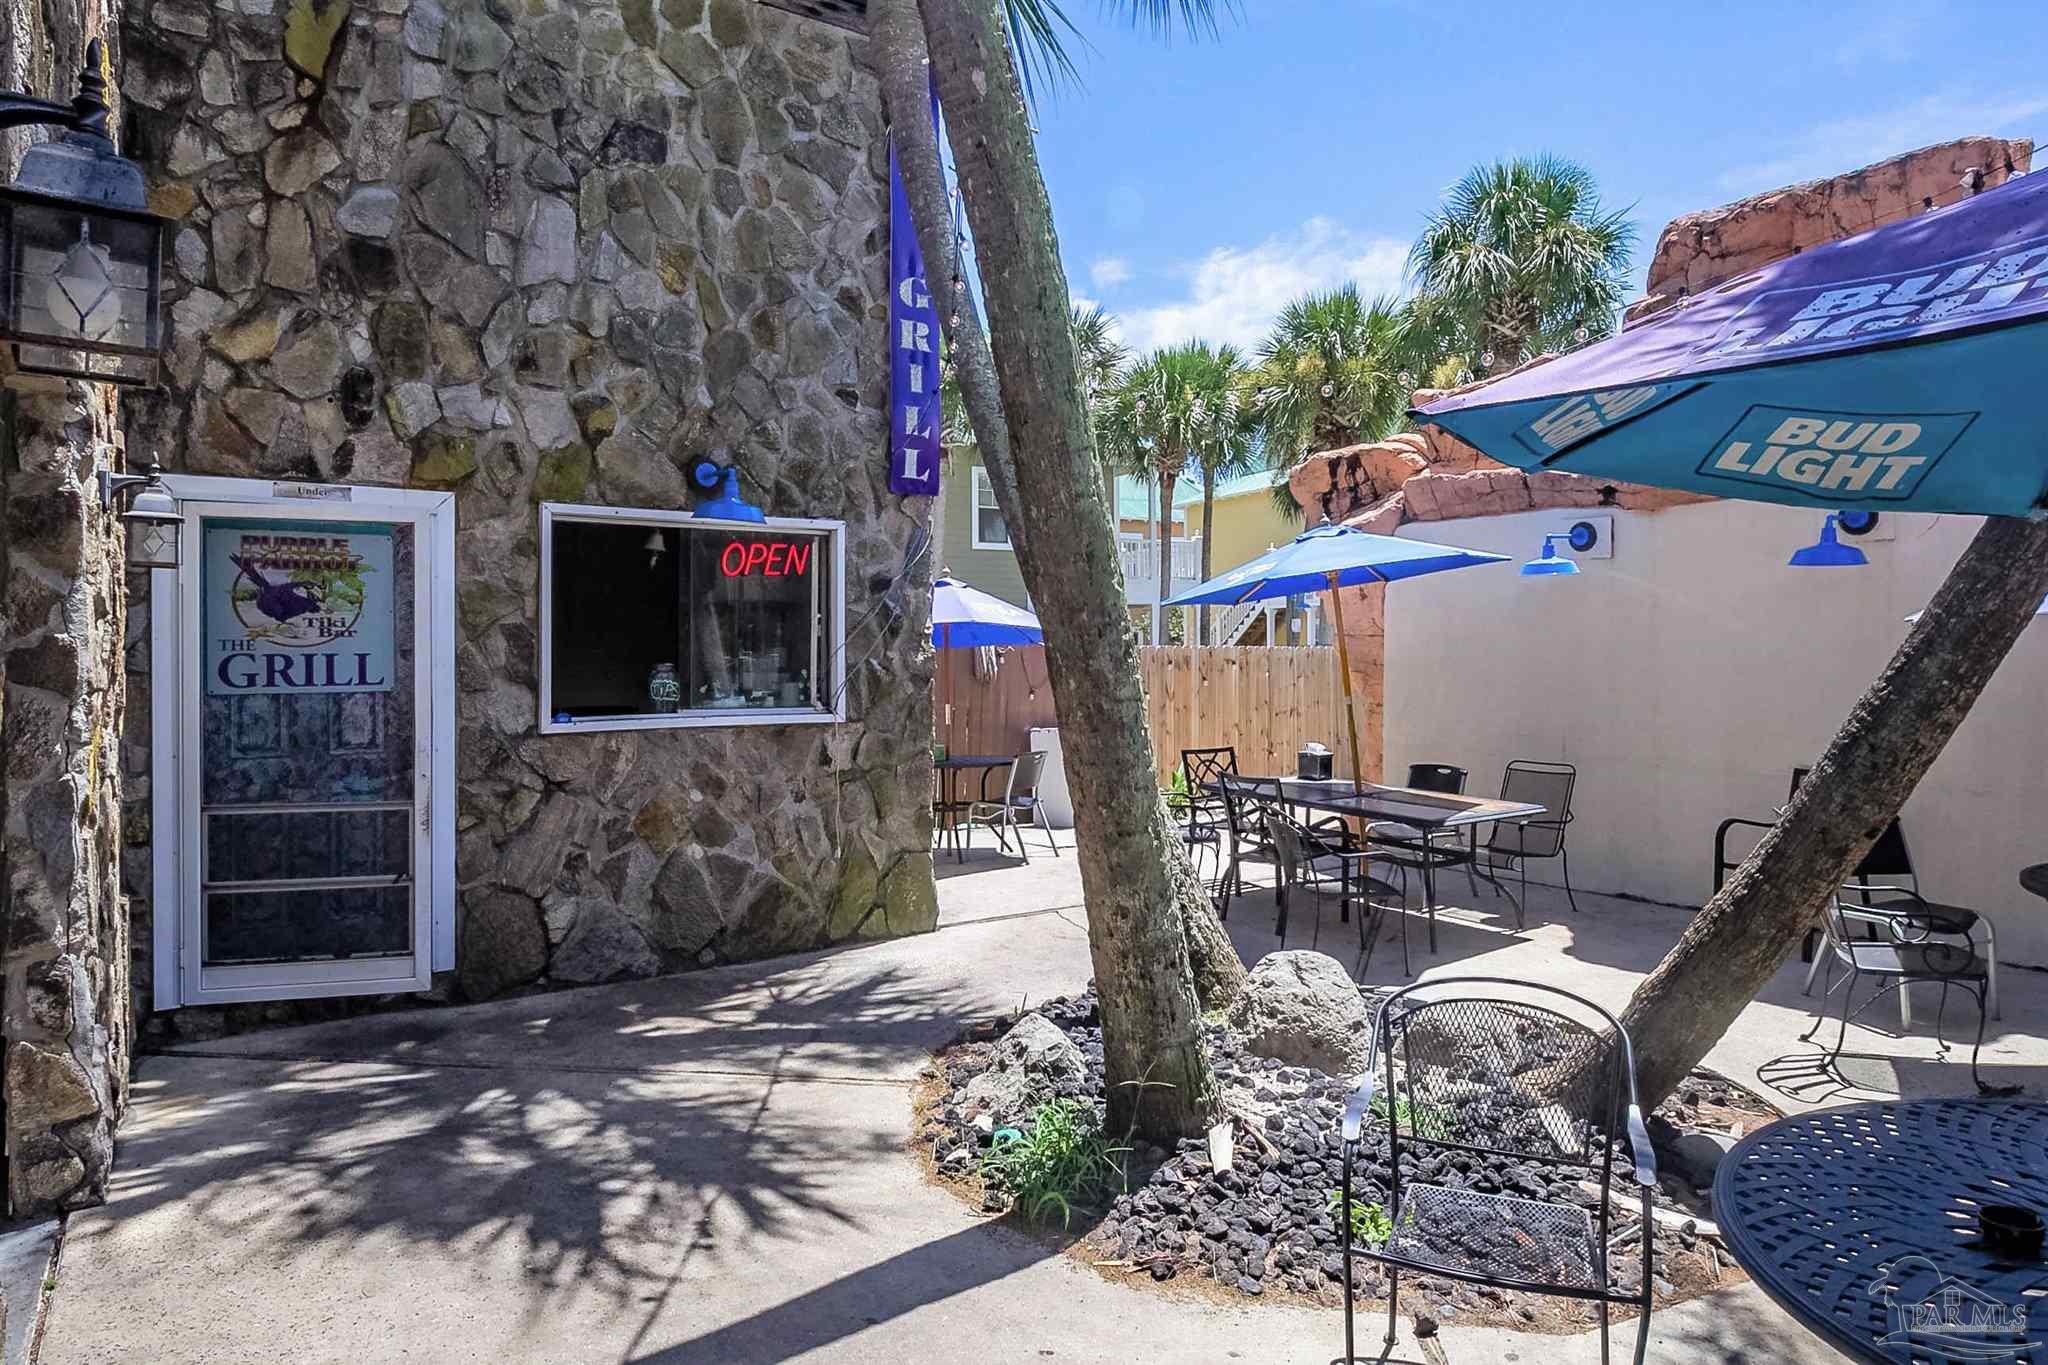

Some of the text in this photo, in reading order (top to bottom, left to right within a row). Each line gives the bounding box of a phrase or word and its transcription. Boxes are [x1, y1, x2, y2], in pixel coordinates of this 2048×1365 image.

[1789, 244, 2048, 321] BUD
[898, 276, 932, 482] GRILL
[1765, 416, 1922, 454] BUD
[1713, 441, 1928, 491] LIGHT
[720, 543, 810, 577] OPEN
[302, 616, 346, 628] Tiki
[319, 626, 358, 638] Bar
[217, 638, 256, 652] THE
[217, 653, 385, 688] GRILL
